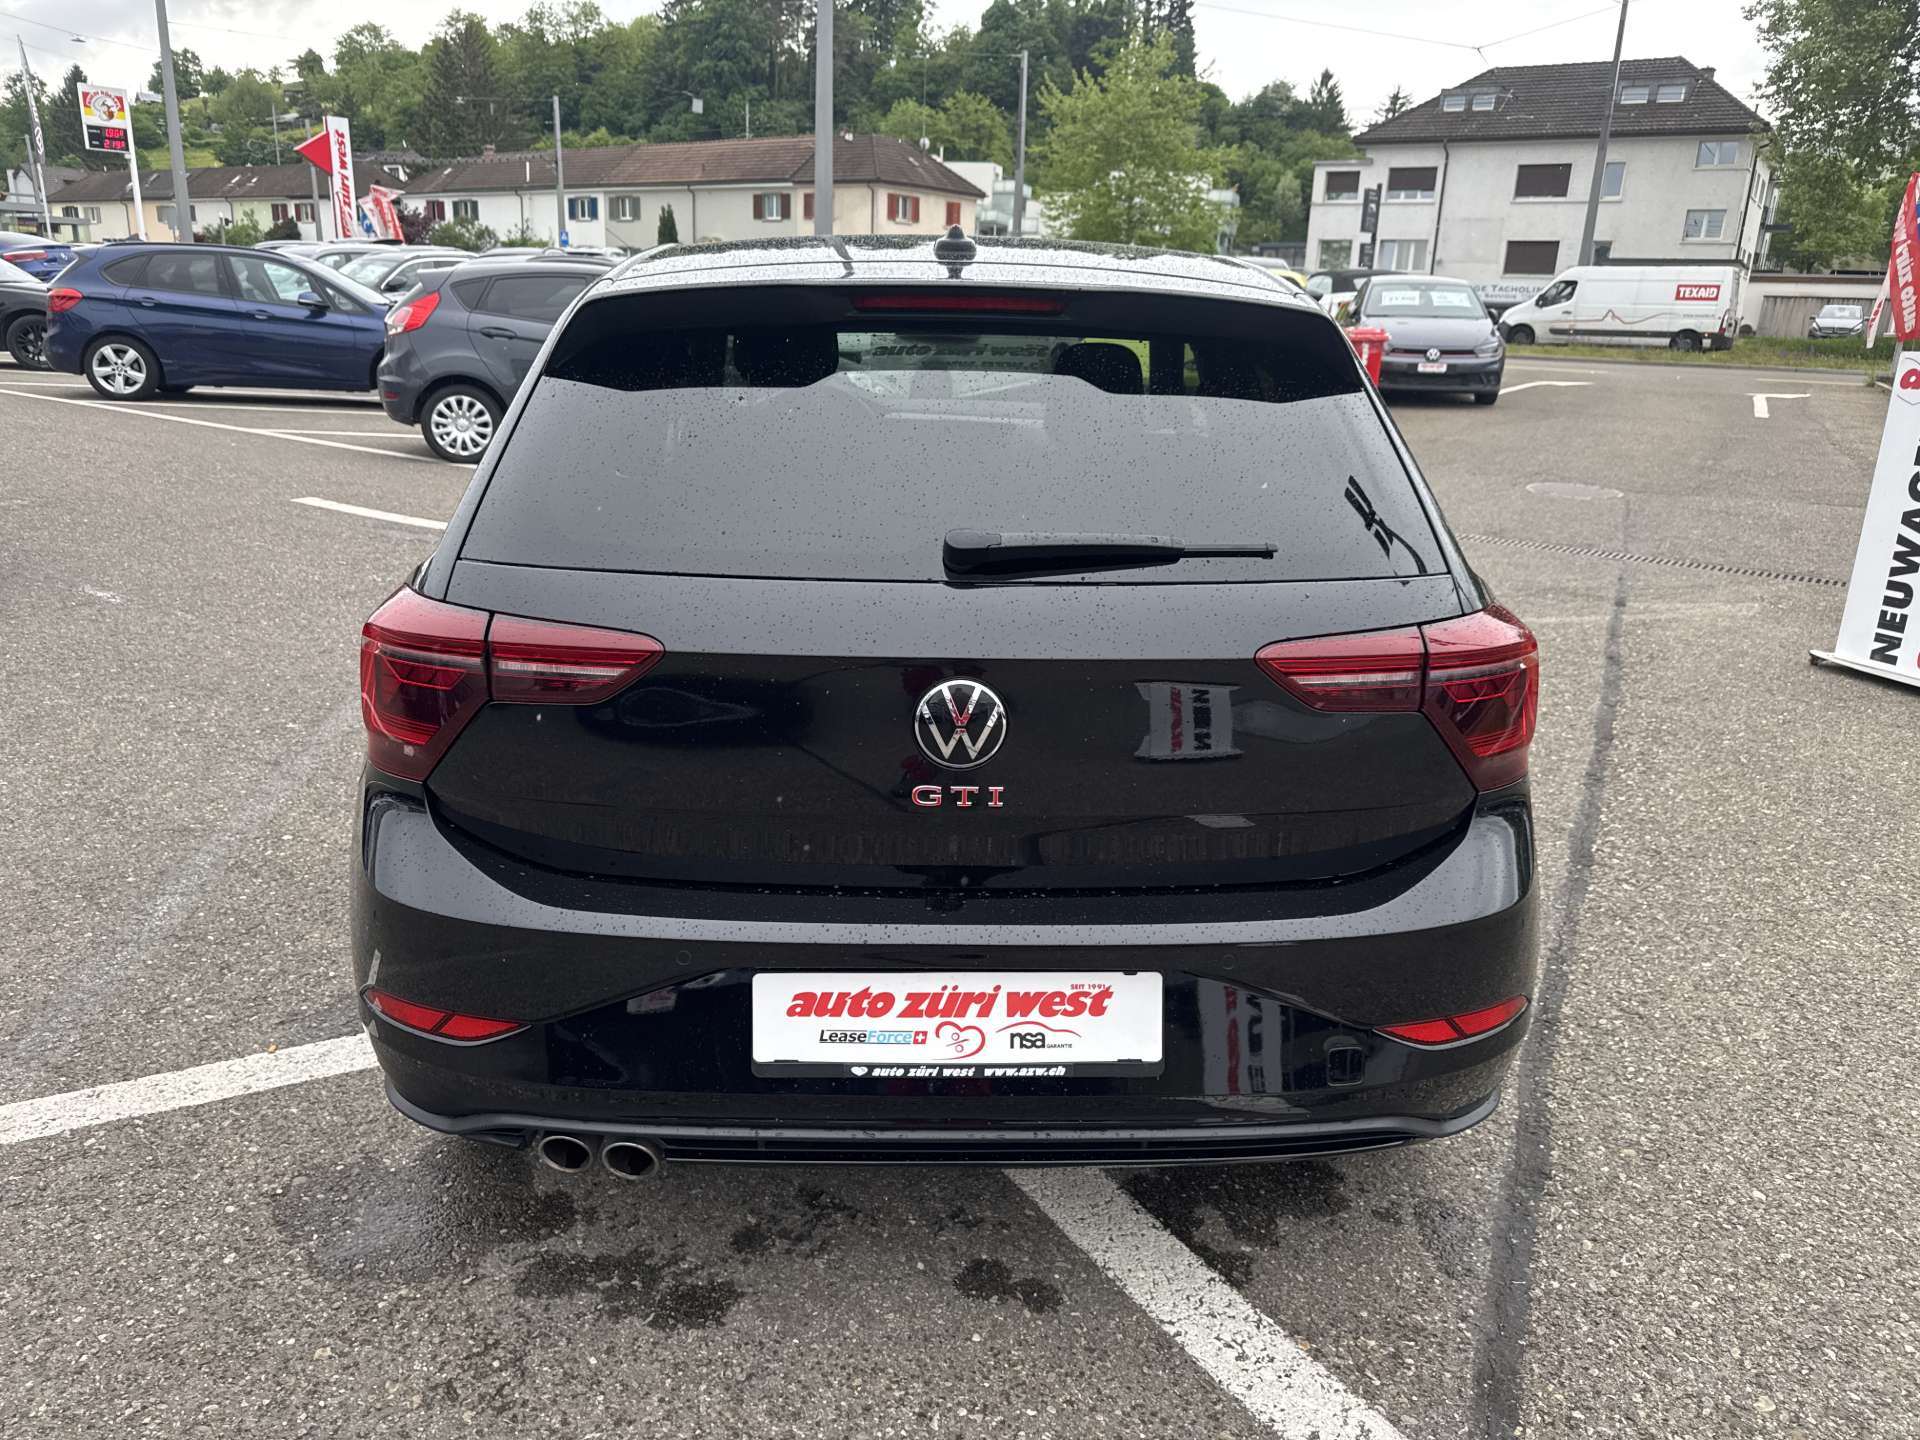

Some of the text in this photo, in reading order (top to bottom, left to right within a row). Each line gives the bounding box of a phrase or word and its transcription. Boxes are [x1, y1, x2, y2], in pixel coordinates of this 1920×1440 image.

[1678, 286, 1718, 299] TEXAID
[912, 785, 1005, 807] GTI
[786, 984, 1114, 1018] auto züri west
[819, 1030, 912, 1044] LeaseForce
[1009, 1032, 1046, 1049] nsa
[871, 1065, 1066, 1077] auto züri west www.azw.ch
